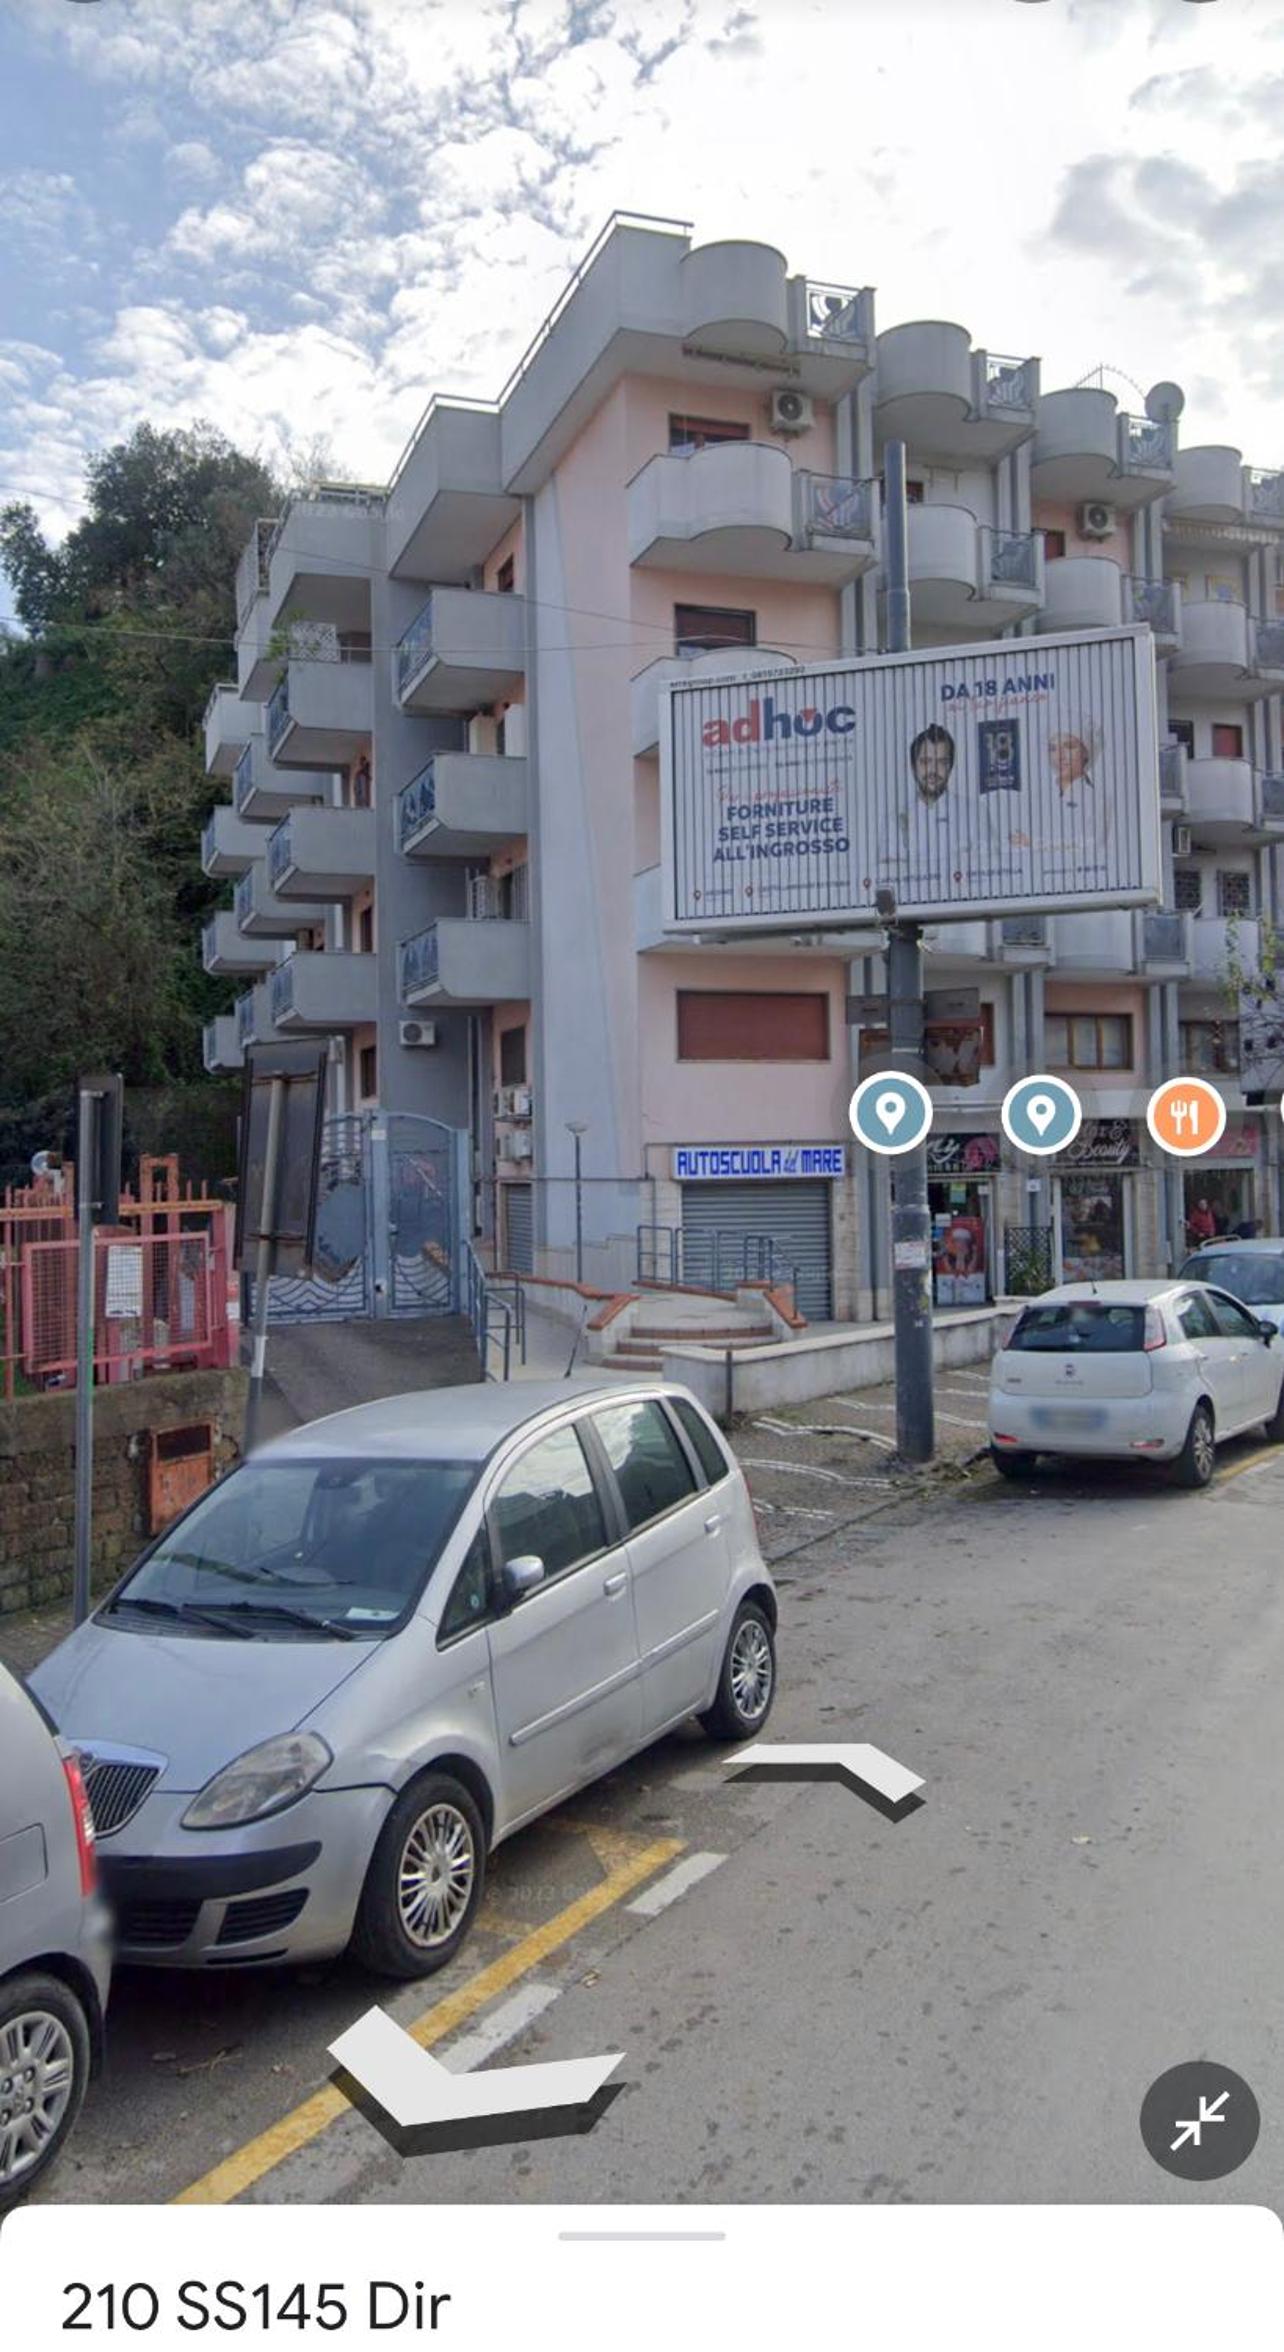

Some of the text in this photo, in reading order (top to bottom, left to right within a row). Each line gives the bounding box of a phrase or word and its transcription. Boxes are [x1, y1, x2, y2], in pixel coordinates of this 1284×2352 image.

[941, 672, 1055, 702] DA 18 ANNI
[702, 696, 857, 748] adhoc
[727, 797, 834, 821] FORNITURE
[718, 816, 844, 843] SELF SERVICE
[713, 837, 850, 863] ALL'INGROSSO
[677, 1150, 782, 1176] AUTOSCUOLA
[801, 1149, 842, 1173] MARE
